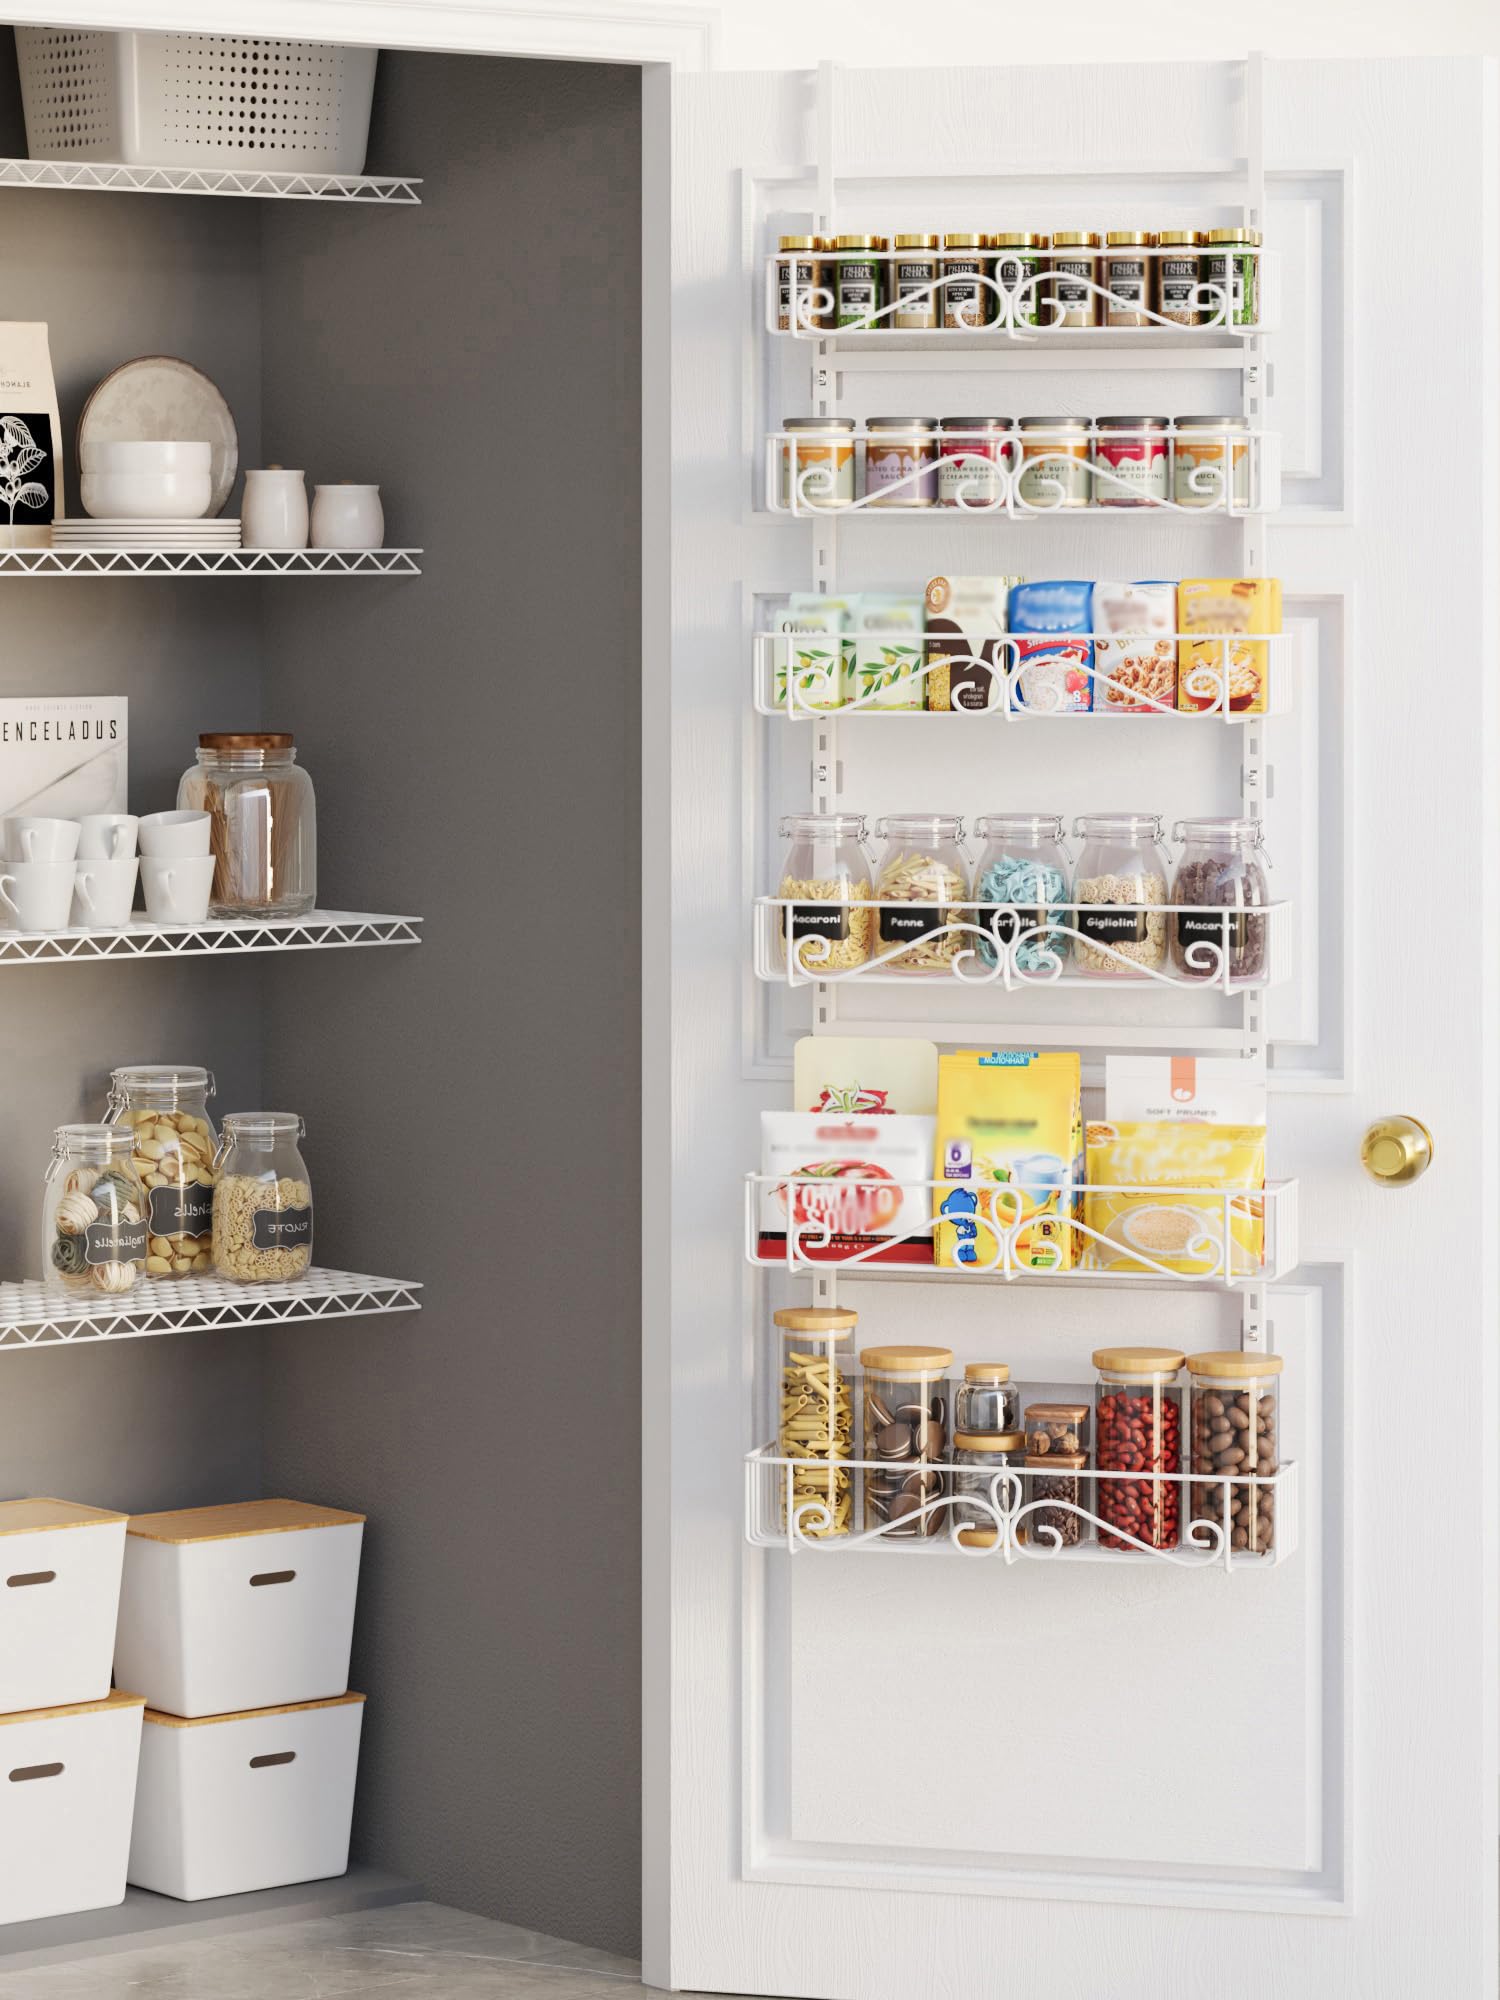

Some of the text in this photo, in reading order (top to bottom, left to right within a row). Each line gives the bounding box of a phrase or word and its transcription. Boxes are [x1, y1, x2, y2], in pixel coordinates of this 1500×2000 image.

[1073, 690, 1082, 703] 8
[3, 719, 117, 742] ENCELADUS
[890, 917, 925, 928] Penne
[1086, 917, 1138, 930] Gigliolini
